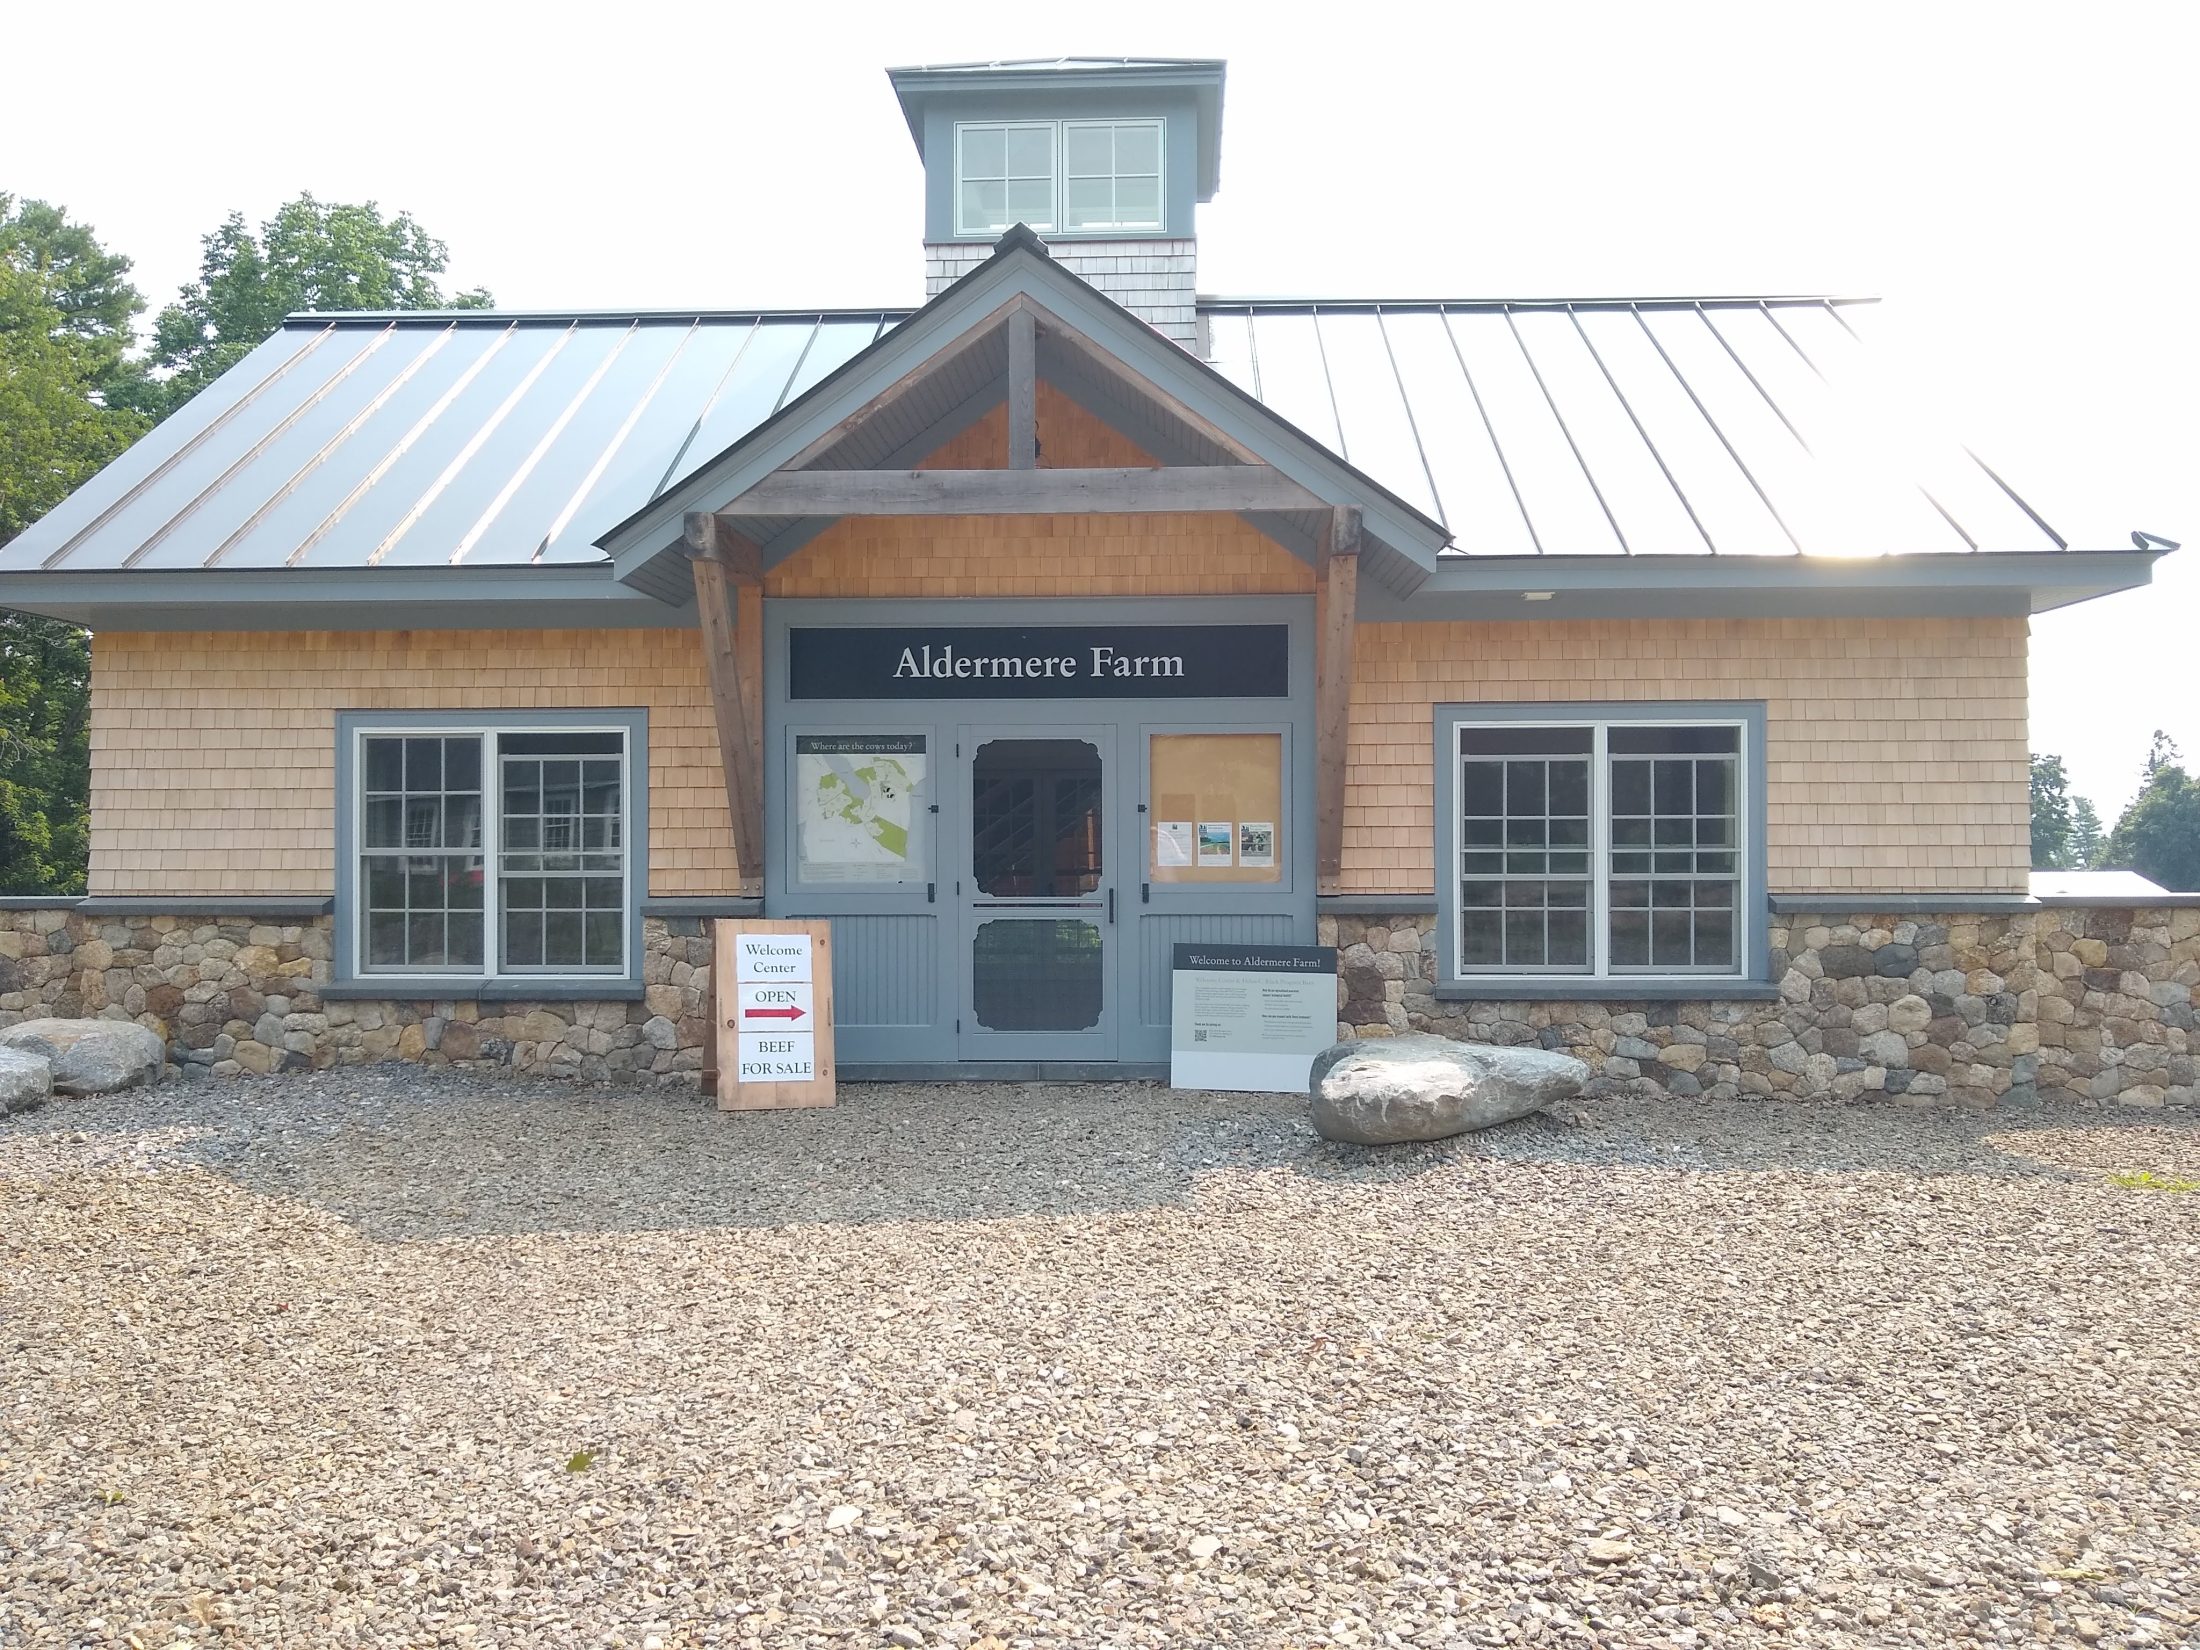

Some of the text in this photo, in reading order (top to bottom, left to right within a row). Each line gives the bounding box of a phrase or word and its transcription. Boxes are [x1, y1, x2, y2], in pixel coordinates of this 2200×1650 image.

[892, 644, 1185, 678] Aldermere Farm
[810, 742, 913, 753] Where are the cows today?
[745, 944, 803, 956] Welcome
[753, 962, 796, 973] Center
[1189, 955, 1321, 969] Welcome to Aldermere Farm!
[755, 991, 797, 1003] OPEN
[758, 1041, 795, 1053] BEEF
[742, 1061, 812, 1075] FOR SALE
